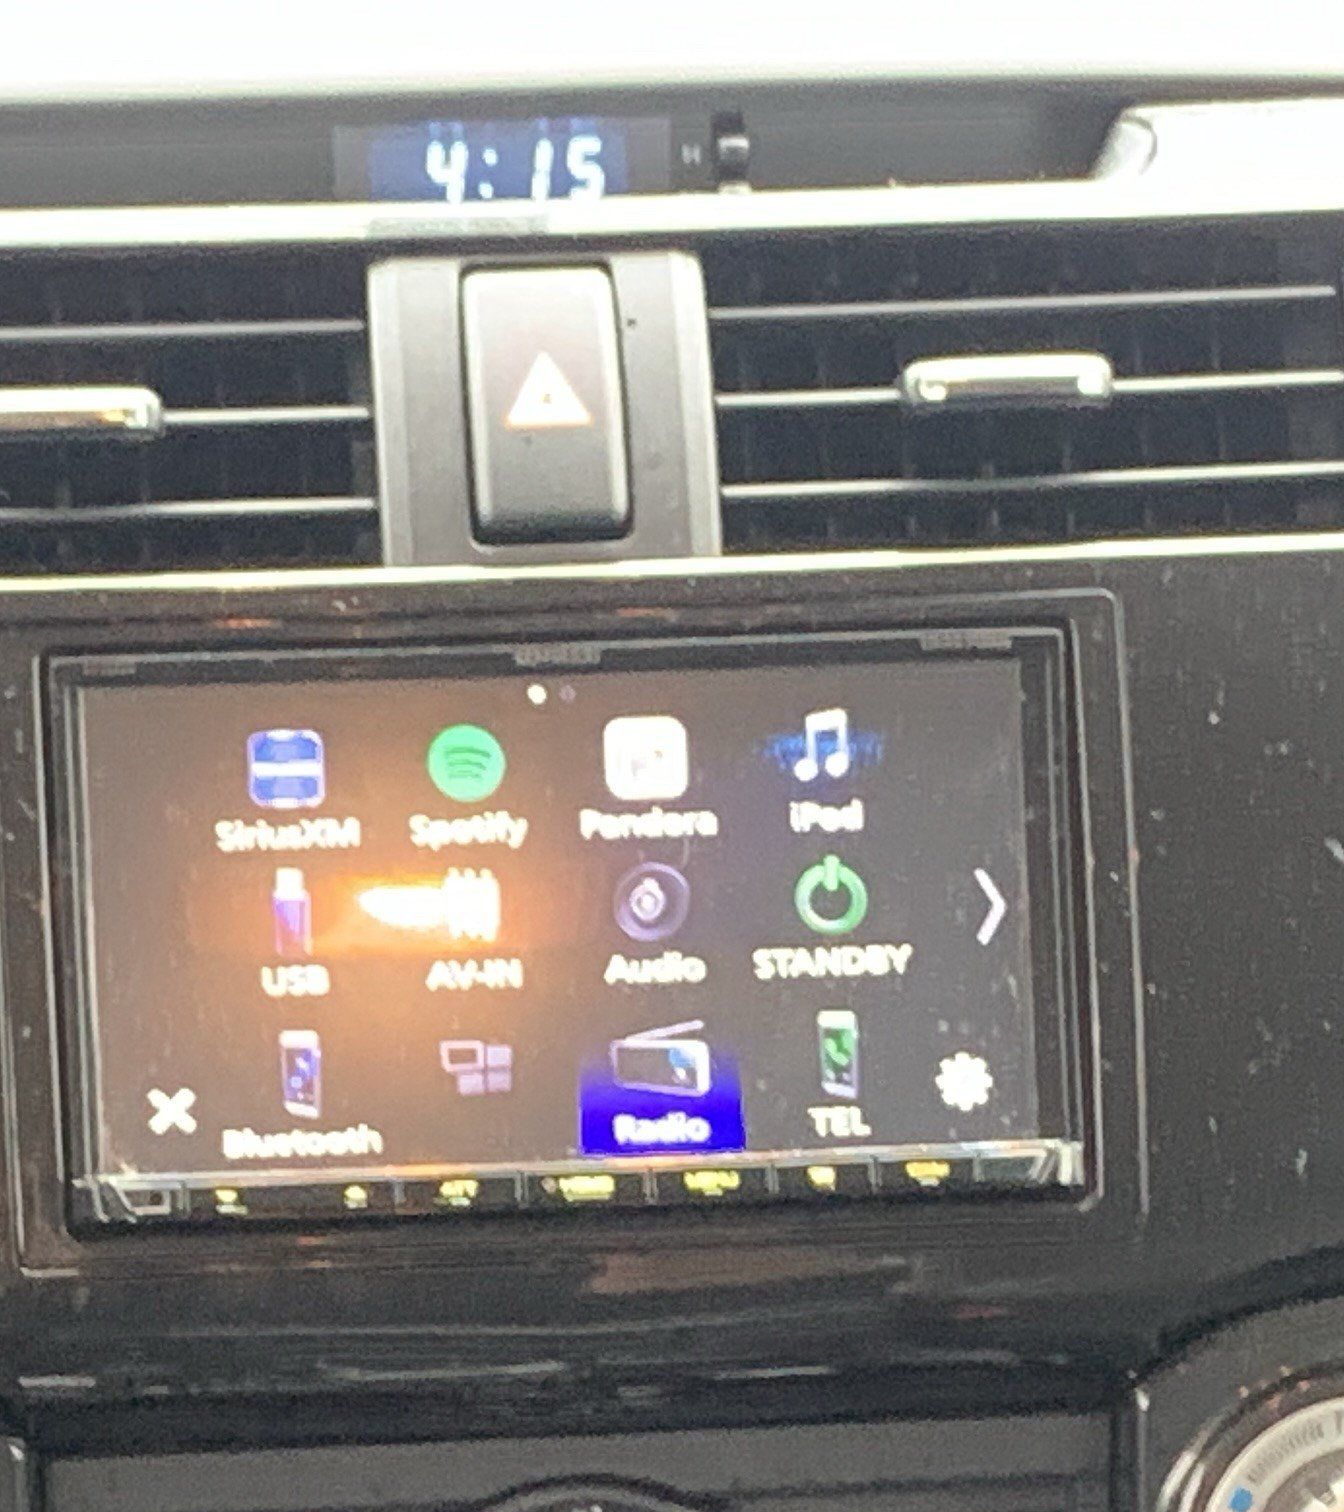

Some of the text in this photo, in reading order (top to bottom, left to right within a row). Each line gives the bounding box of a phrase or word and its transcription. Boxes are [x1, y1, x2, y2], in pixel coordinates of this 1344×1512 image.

[425, 136, 605, 202] 4:15
[409, 810, 528, 851] Spotify
[580, 805, 719, 840] Pandora
[790, 798, 864, 832] iPod
[215, 816, 361, 853] SiriusXM
[425, 958, 524, 990] AV-IN
[604, 951, 707, 985] Audio
[752, 943, 913, 979] STANDBY
[260, 964, 330, 997] USB
[612, 1111, 712, 1145] Radio
[806, 1105, 872, 1138] TEL
[222, 1123, 383, 1160] Bluetooth
